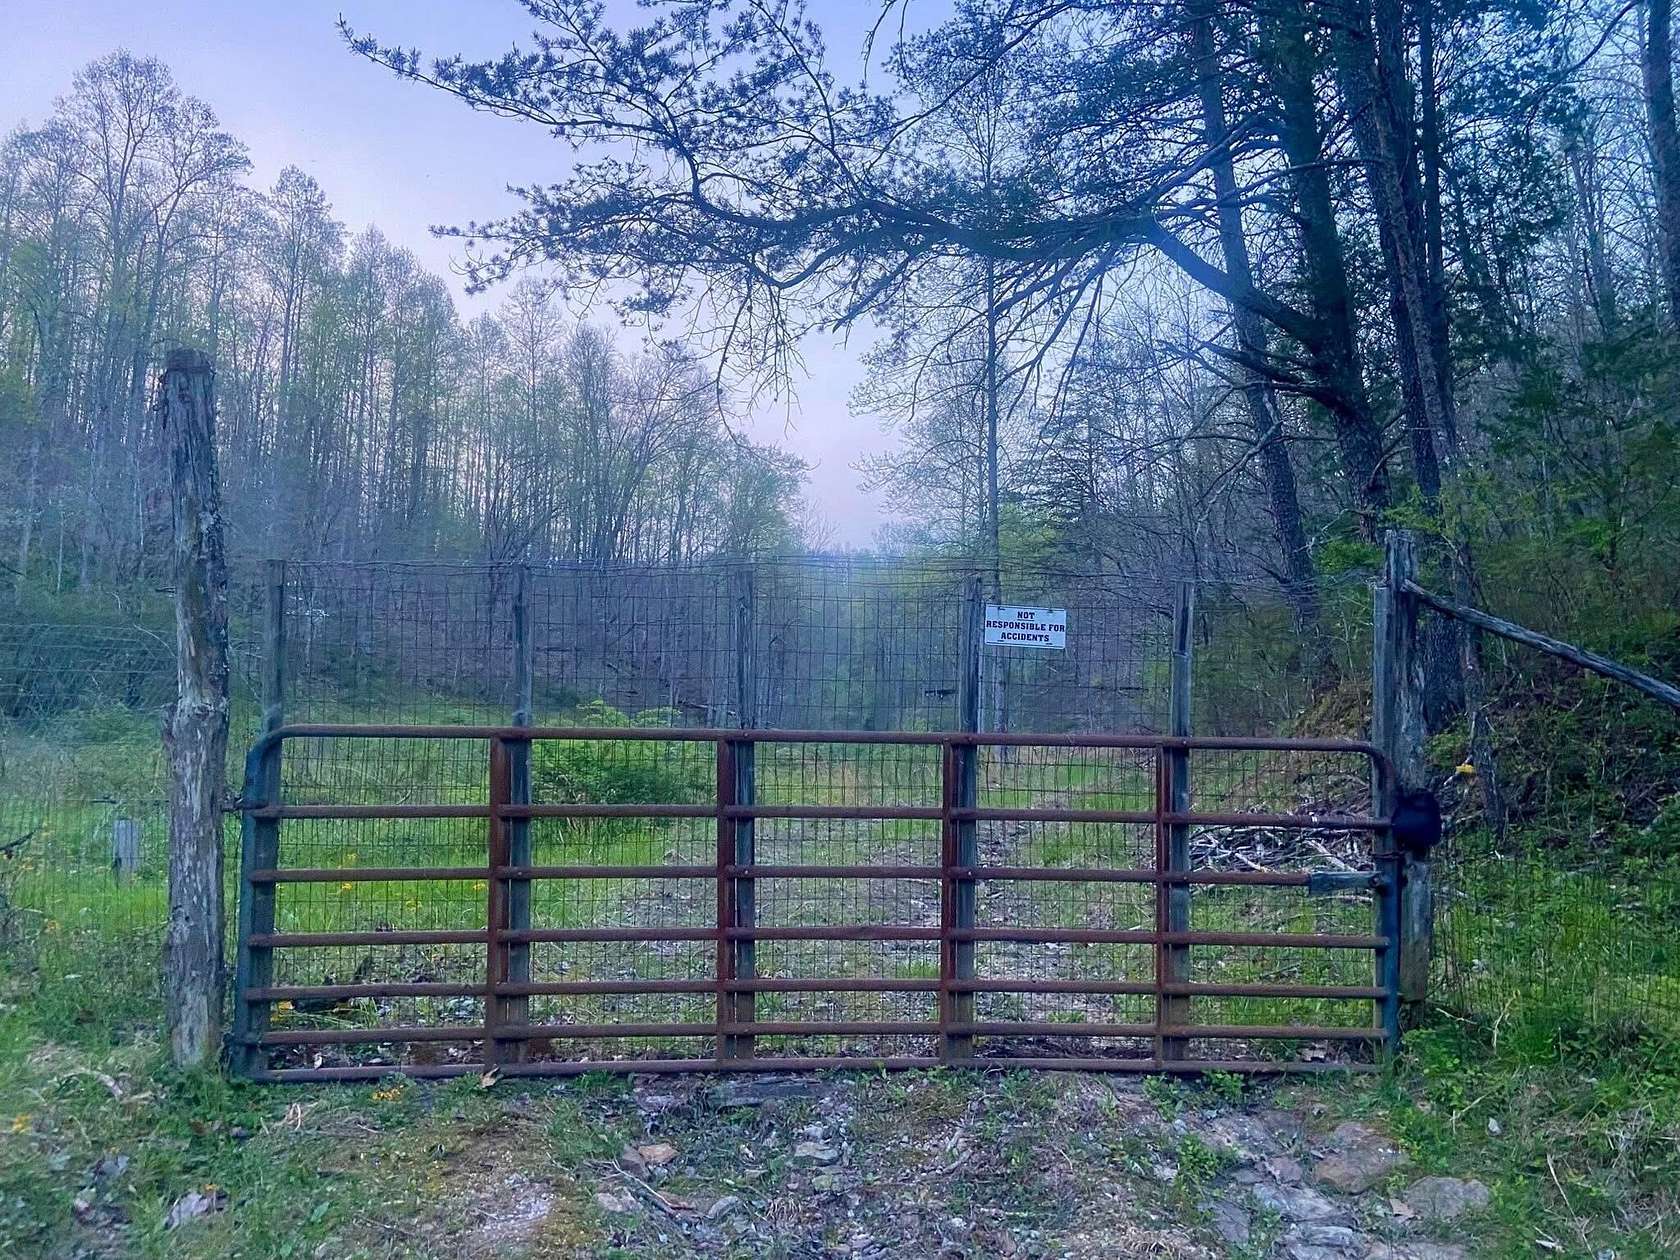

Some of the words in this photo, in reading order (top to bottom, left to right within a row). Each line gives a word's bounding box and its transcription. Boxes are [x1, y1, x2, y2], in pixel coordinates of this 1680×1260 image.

[1017, 611, 1035, 619] NOT
[986, 620, 1046, 631] RESPONSIBLE
[1048, 624, 1065, 632] FOR
[1001, 632, 1049, 642] ACCIDENTS
